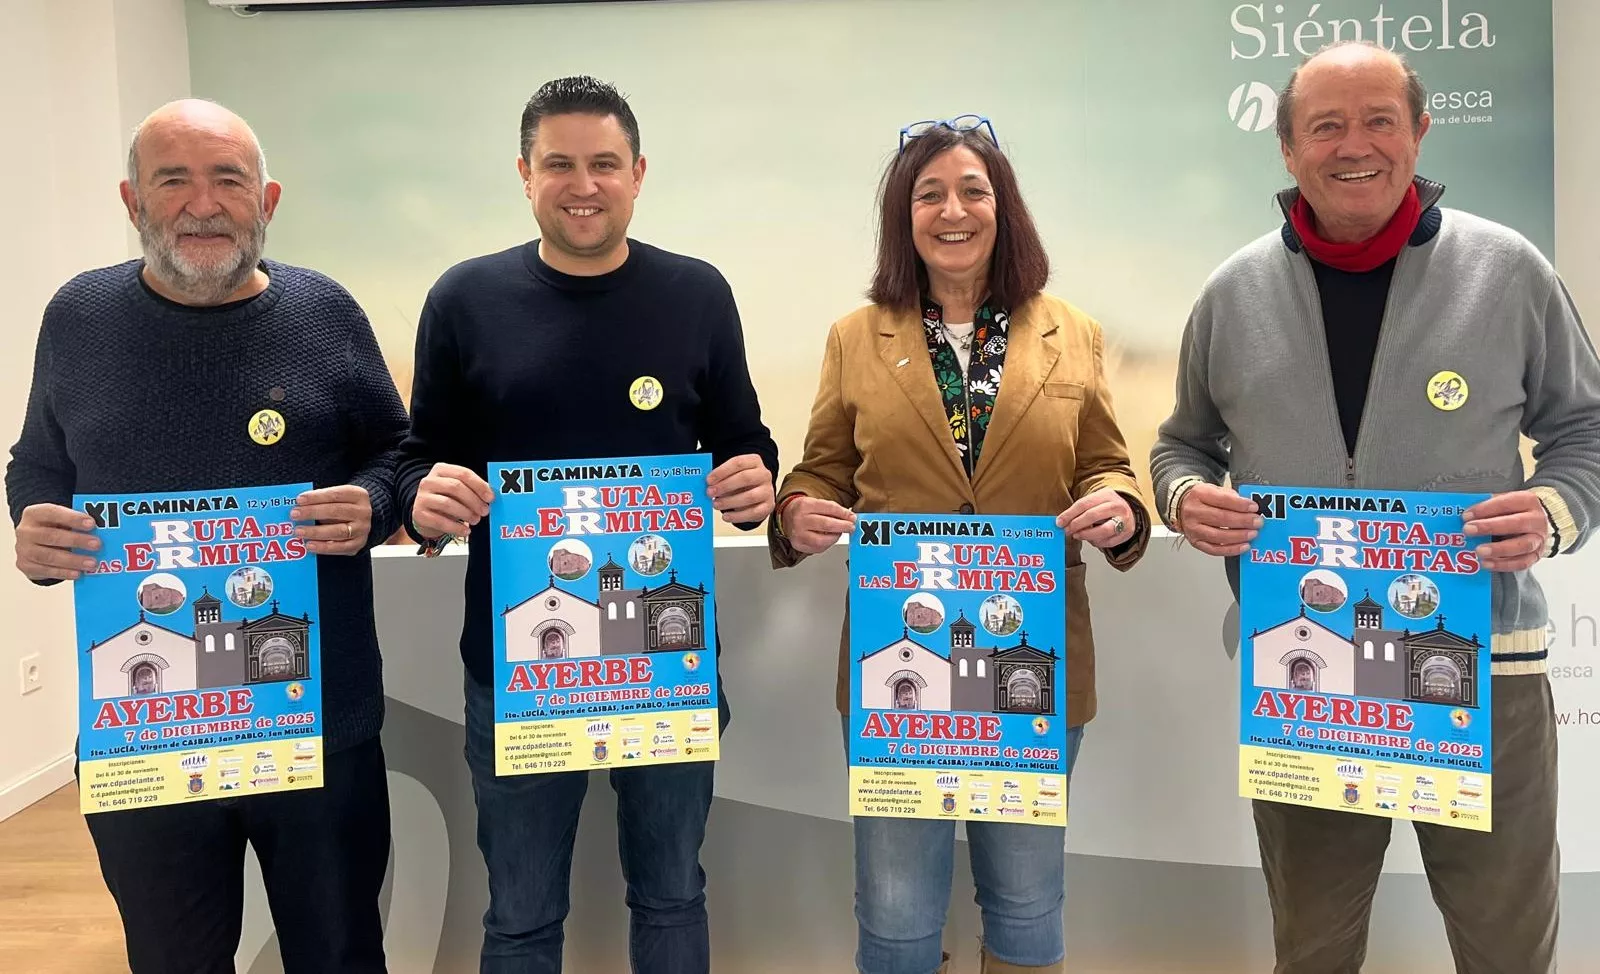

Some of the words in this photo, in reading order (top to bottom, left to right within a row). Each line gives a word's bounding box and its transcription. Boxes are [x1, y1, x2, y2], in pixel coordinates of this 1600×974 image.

[1230, 0, 1496, 59] Siéntela
[1425, 90, 1493, 110] esca
[1448, 115, 1460, 124] de
[1463, 114, 1493, 124] Uesca
[500, 468, 533, 493] XI
[536, 463, 642, 481] CAMINATA
[562, 483, 664, 510] RUTA
[665, 492, 692, 505] DE
[1252, 493, 1285, 518] XI
[1289, 494, 1406, 513] CAMINATA
[1430, 507, 1436, 515] y
[86, 502, 119, 528] XI
[122, 496, 240, 516] CAMINATA
[501, 525, 535, 538] LAS
[537, 502, 704, 537] ERMITAS
[151, 515, 263, 544] RUTA
[265, 523, 294, 536] DE
[858, 520, 889, 545] XI
[892, 521, 994, 536] CAMINATA
[1316, 516, 1431, 545] RUTA
[1433, 533, 1465, 546] DE
[86, 560, 122, 574] AS
[124, 532, 307, 572] ERMITAS
[916, 542, 1015, 566] RUTA
[1017, 554, 1044, 566] DE
[1251, 550, 1286, 564] LAS
[1289, 536, 1479, 575] ERMITAS
[859, 576, 890, 588] LAS
[892, 562, 1055, 592] ERMITAS
[506, 657, 652, 692] AYERBE
[1551, 665, 1593, 679] esca
[92, 688, 253, 729] AYERBE
[536, 696, 544, 706] 7
[550, 694, 564, 705] de
[570, 688, 650, 703] DICIEMBRE
[655, 687, 670, 698] de
[674, 684, 709, 696] 2025
[550, 708, 574, 716] Virgen
[587, 704, 618, 713] CASBAS,
[636, 701, 664, 710] PABLO,
[1253, 689, 1413, 732] AYERBE
[125, 732, 134, 742] 7
[140, 728, 157, 740] de
[162, 719, 251, 738] DICIEMBRE
[256, 717, 272, 728] de
[277, 712, 315, 726] 2025
[140, 742, 167, 751] Virgen
[182, 737, 216, 746] CASBAS,
[235, 731, 267, 741] PABLO,
[285, 727, 316, 735] MIGUEL
[861, 712, 1001, 741] AYERBE
[889, 744, 896, 753] 7
[902, 743, 915, 754] de
[920, 744, 998, 757] DICIEMBRE
[1003, 747, 1018, 758] de
[1023, 748, 1058, 759] 2025
[1283, 725, 1291, 735] 7
[1297, 726, 1313, 738] de
[1319, 728, 1410, 749] DICIEMBRE
[1416, 739, 1433, 752] de
[1439, 741, 1482, 758] 2025
[1297, 740, 1323, 750] Virgen
[1338, 745, 1373, 756] CASBAS,
[1393, 752, 1427, 762] PABLO,
[1447, 758, 1482, 768] MIGUEL
